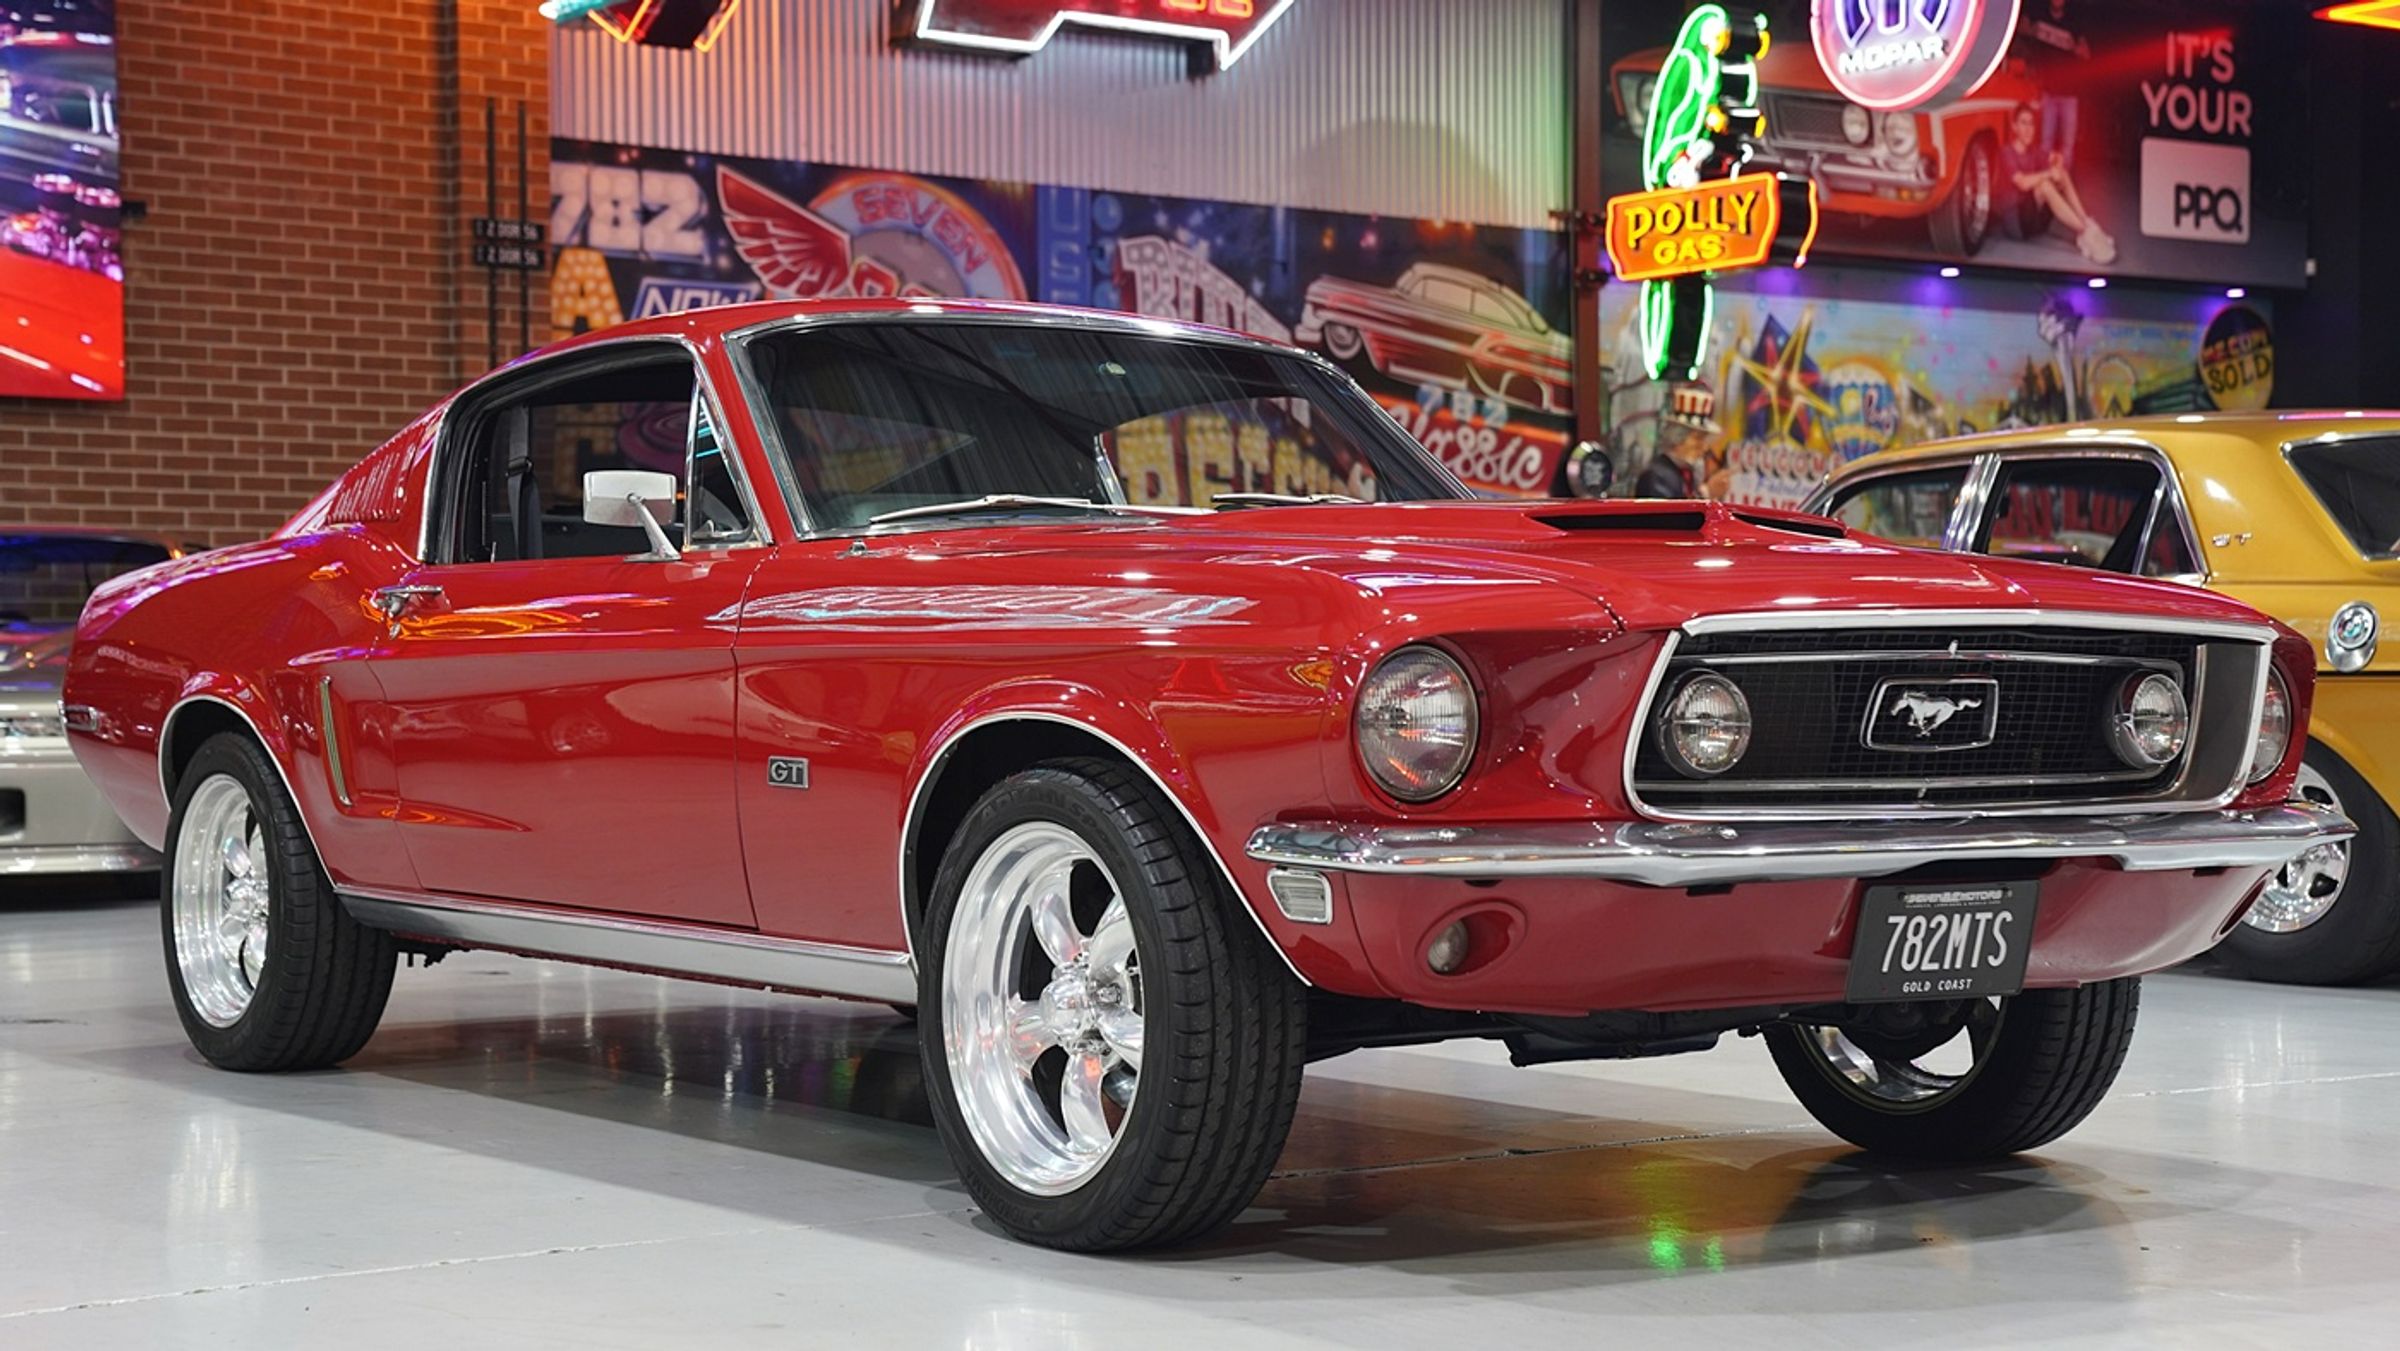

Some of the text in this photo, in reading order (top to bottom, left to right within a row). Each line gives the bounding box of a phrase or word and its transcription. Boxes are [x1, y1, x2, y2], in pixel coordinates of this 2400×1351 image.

[1839, 38, 1948, 75] MOPAR
[2165, 31, 2235, 82] IT'S
[2141, 81, 2253, 136] YOUR
[852, 186, 990, 274] SEVEN
[1624, 191, 1759, 249] POLLY
[2173, 183, 2244, 233] PPQ
[1652, 235, 1725, 265] GAS
[2207, 354, 2270, 394] SOLD
[771, 761, 803, 782] GT
[1881, 911, 2013, 973] 782MTS
[1902, 978, 1973, 993] GOLD COAST
